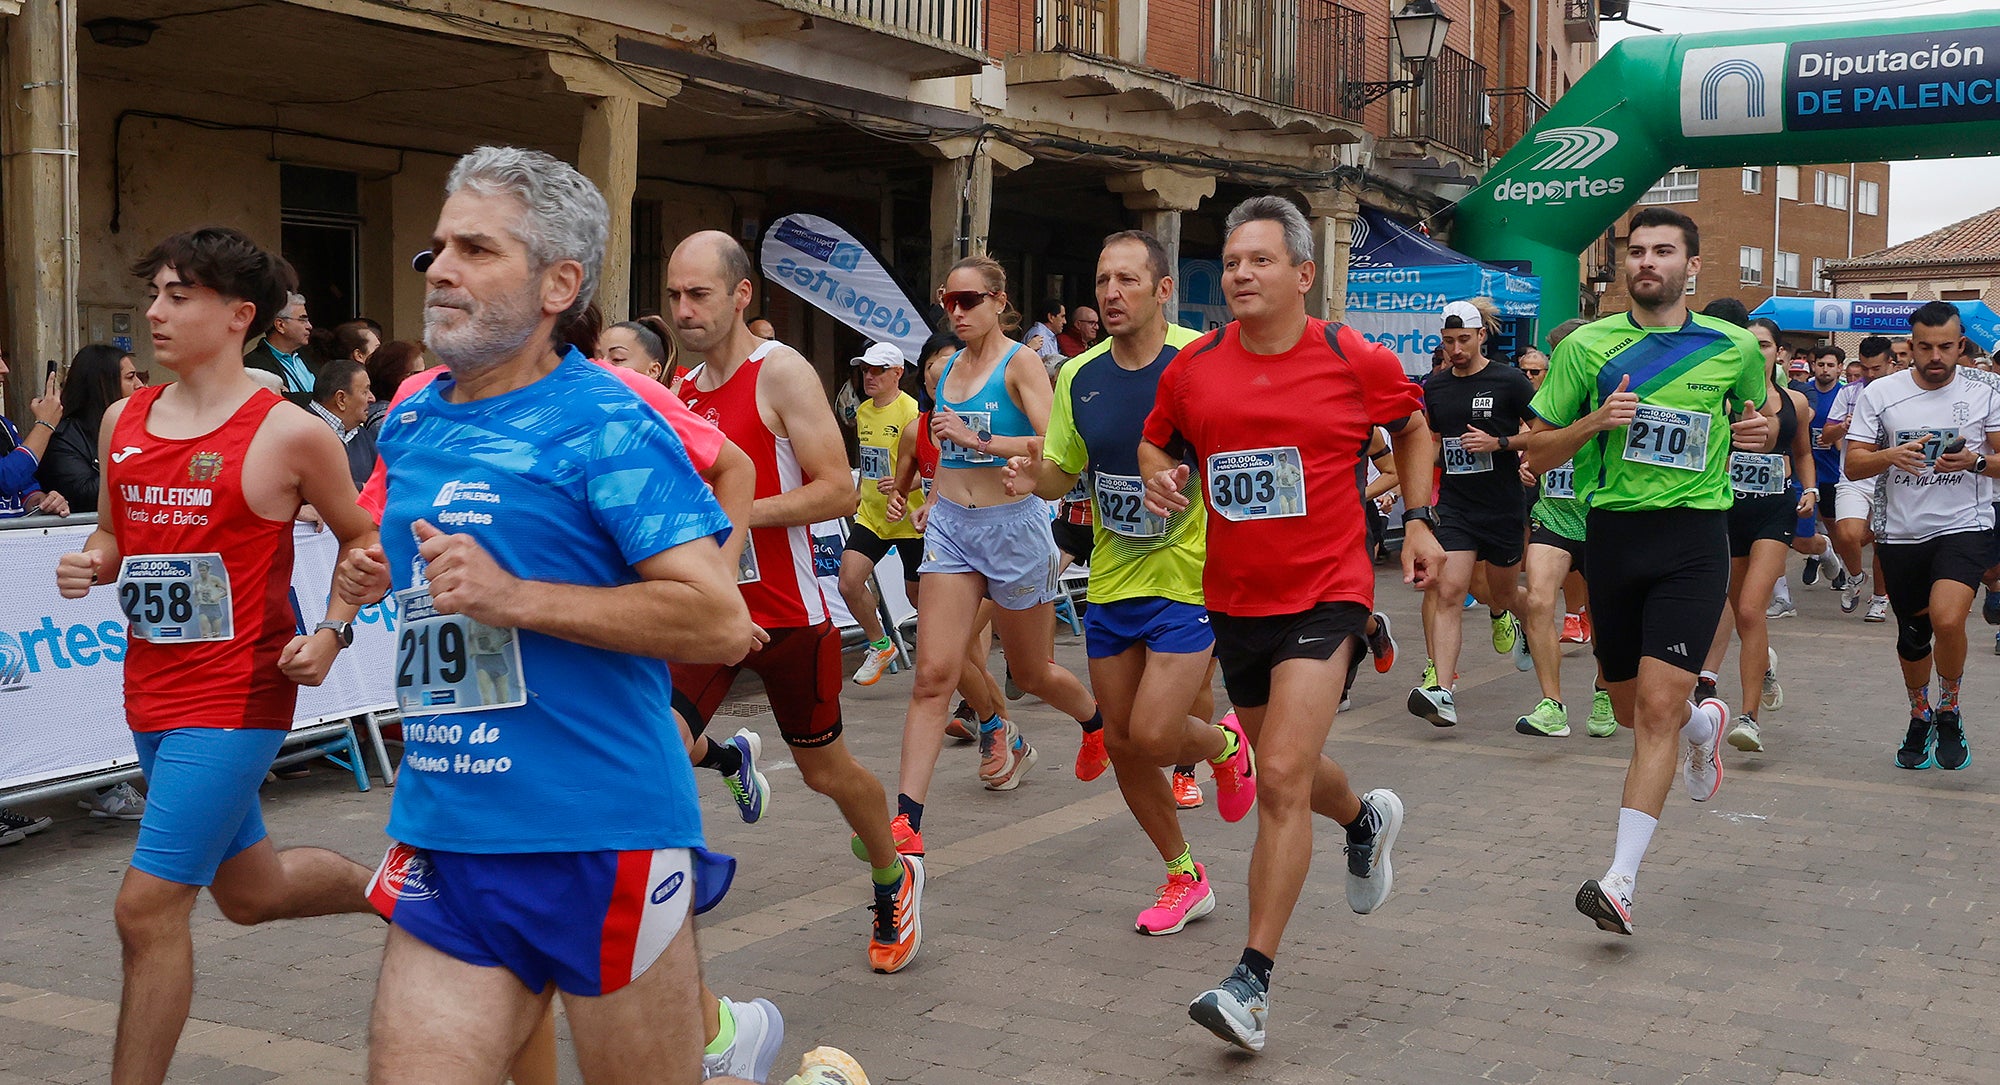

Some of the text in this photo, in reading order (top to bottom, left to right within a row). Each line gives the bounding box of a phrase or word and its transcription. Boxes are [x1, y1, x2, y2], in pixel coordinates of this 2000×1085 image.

[1799, 42, 1984, 81] Diputación
[1797, 89, 1842, 115] DE
[1493, 175, 1625, 205] deportes
[1855, 317, 1870, 326] DE
[1474, 398, 1490, 408] BAR
[1629, 421, 1687, 455] 210
[1228, 455, 1257, 464] 10.000
[1446, 448, 1476, 467] 288
[1731, 463, 1770, 485] 326
[144, 485, 212, 506] ATLETISMO
[1214, 470, 1275, 507] 303
[152, 511, 170, 525] de
[438, 510, 493, 525] deportes
[1099, 490, 1142, 524] 322
[121, 582, 193, 624] 258
[398, 622, 467, 688] 219
[468, 722, 500, 745] de
[453, 753, 512, 775] Haro
